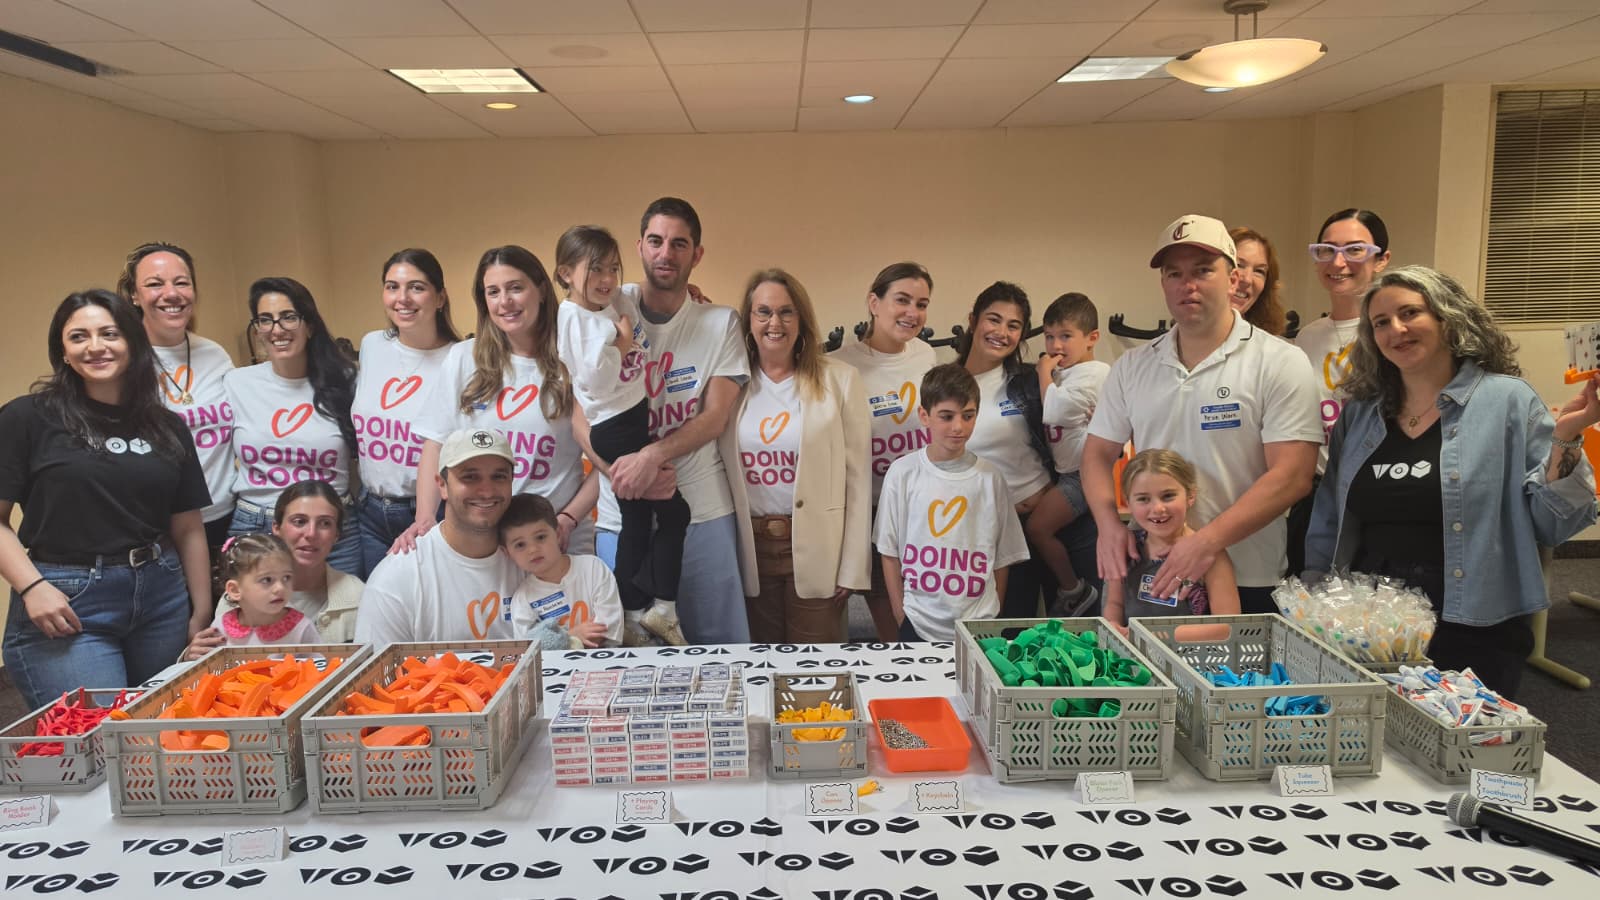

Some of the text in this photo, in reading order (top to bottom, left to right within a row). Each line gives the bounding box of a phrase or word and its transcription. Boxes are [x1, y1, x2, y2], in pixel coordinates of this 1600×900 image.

[178, 401, 234, 428] ING
[872, 427, 932, 457] DOIN
[241, 444, 338, 468] DOING
[741, 450, 799, 468] DOIN
[247, 465, 338, 487] GOOD
[746, 468, 796, 486] GOO
[902, 543, 988, 575] DOING
[902, 567, 986, 598] GOOD
